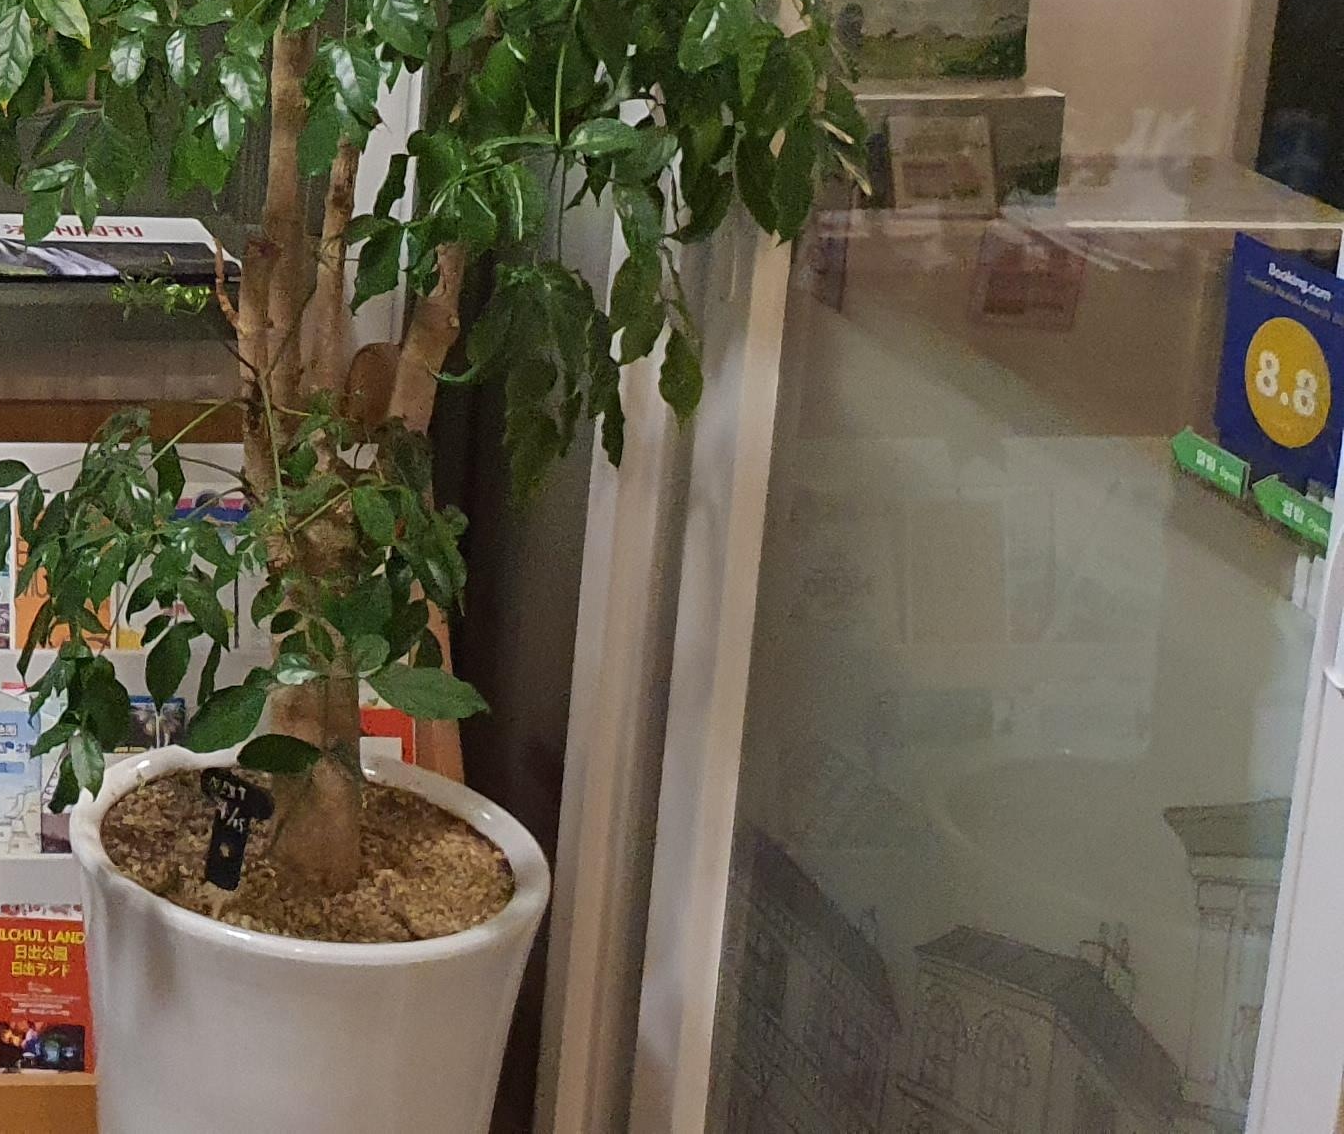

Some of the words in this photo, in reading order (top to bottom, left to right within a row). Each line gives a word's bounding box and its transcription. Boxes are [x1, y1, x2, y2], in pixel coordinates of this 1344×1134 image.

[1268, 263, 1332, 302] Booking.com
[1256, 349, 1318, 417] 8.8
[48, 930, 85, 944] LAND
[12, 961, 70, 977] 日出ランド
